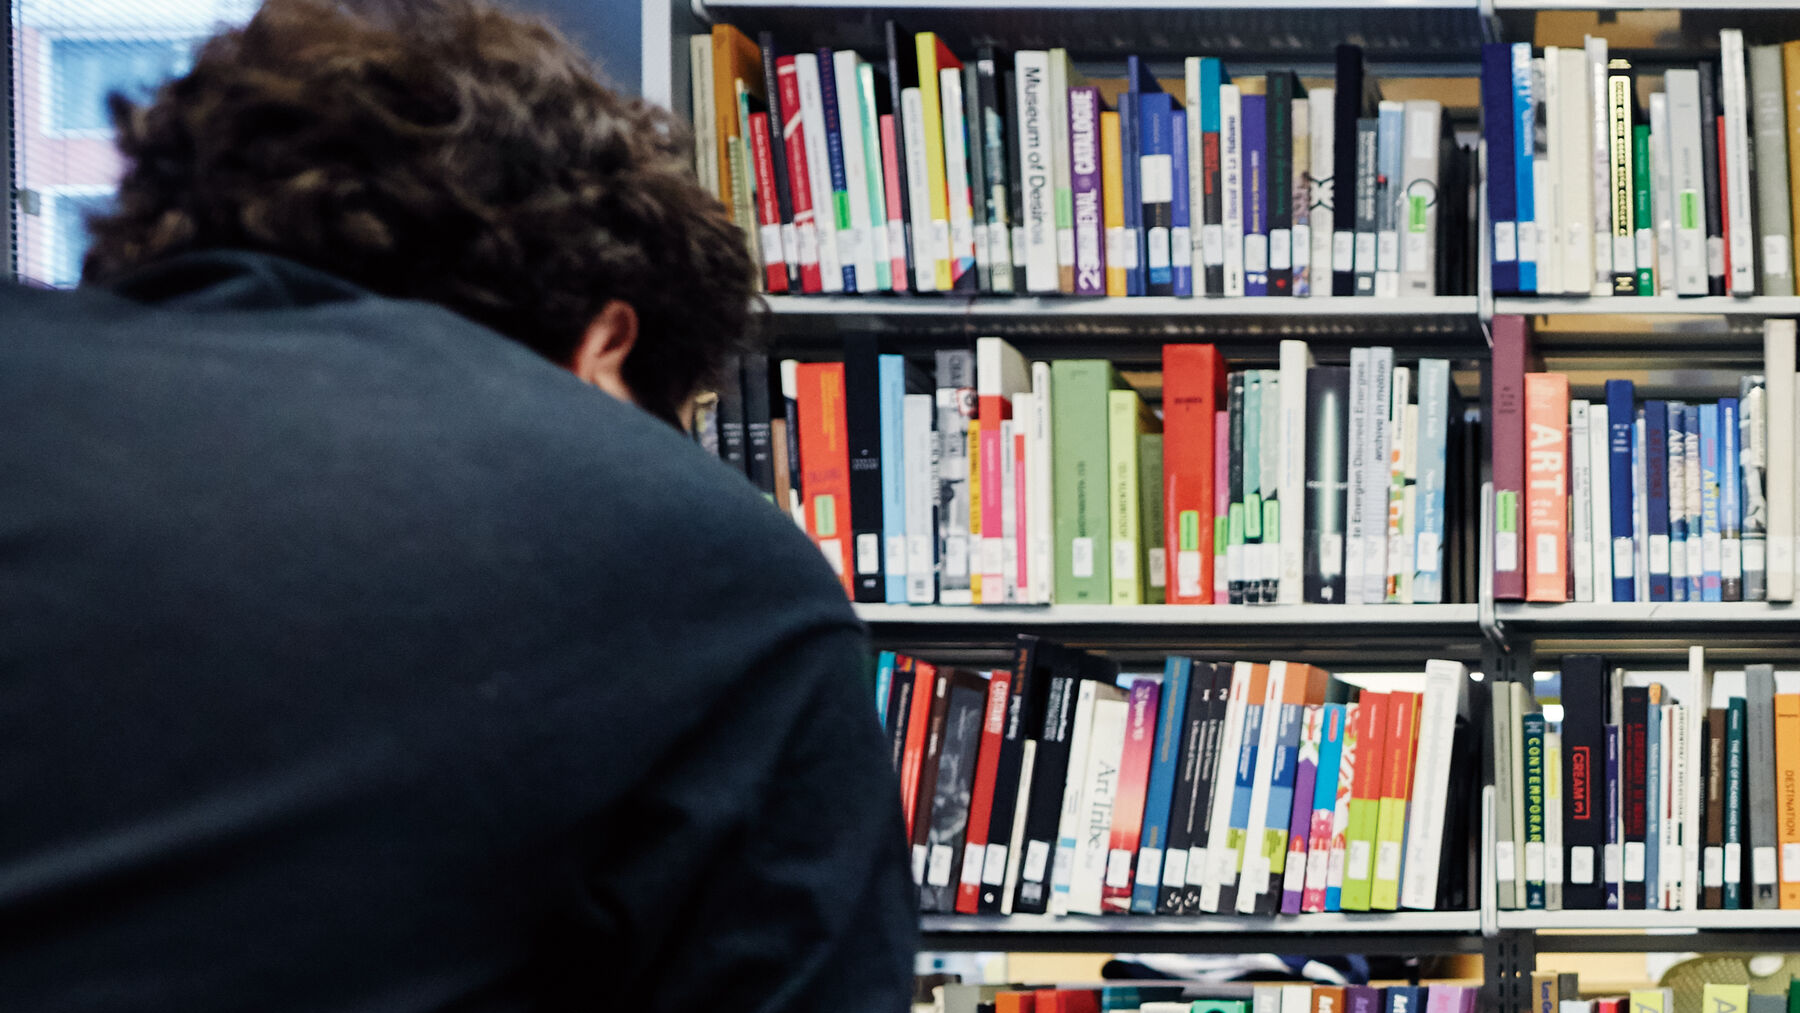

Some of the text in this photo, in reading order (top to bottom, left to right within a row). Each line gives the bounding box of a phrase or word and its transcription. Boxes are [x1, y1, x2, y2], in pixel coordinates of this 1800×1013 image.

[1023, 66, 1043, 149] Museum
[1028, 151, 1045, 171] of
[1374, 359, 1386, 462] archive in motion
[1530, 423, 1563, 496] ART
[1352, 470, 1366, 523] Energien
[1702, 469, 1716, 534] ARTSPEA
[1218, 688, 1228, 700] 2
[1097, 760, 1116, 795] Art
[1528, 737, 1541, 843] CONTEMPORAR
[1573, 752, 1584, 799] CREAM
[1785, 770, 1795, 836] DESTINATION
[1393, 994, 1408, 1013] Art
[1541, 982, 1553, 1000] Les
